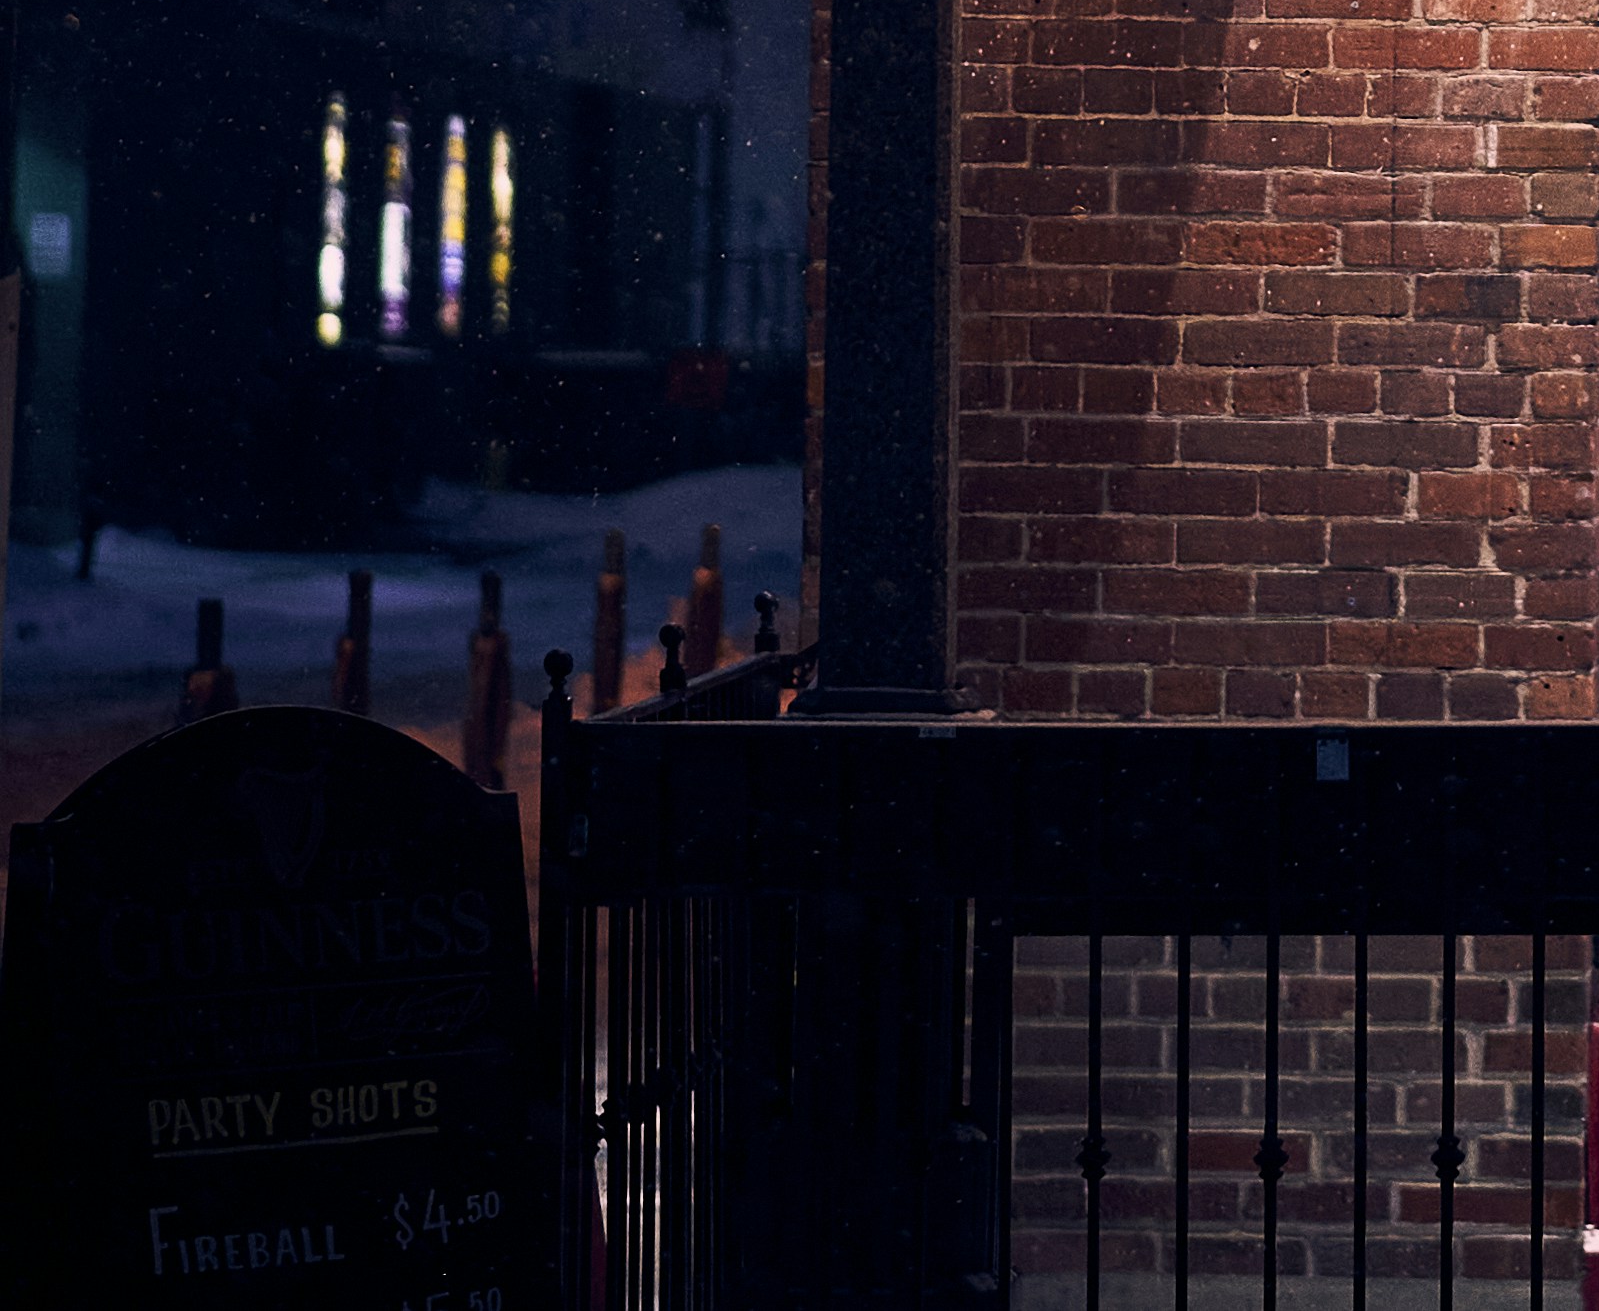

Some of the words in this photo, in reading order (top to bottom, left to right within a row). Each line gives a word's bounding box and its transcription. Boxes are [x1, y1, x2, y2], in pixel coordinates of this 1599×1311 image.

[100, 888, 492, 983] GUINNESS
[148, 1091, 282, 1147] PARTY
[310, 1079, 439, 1130] SHOTS
[148, 1205, 346, 1276] FIREBALL
[393, 1188, 501, 1252] $4.50
